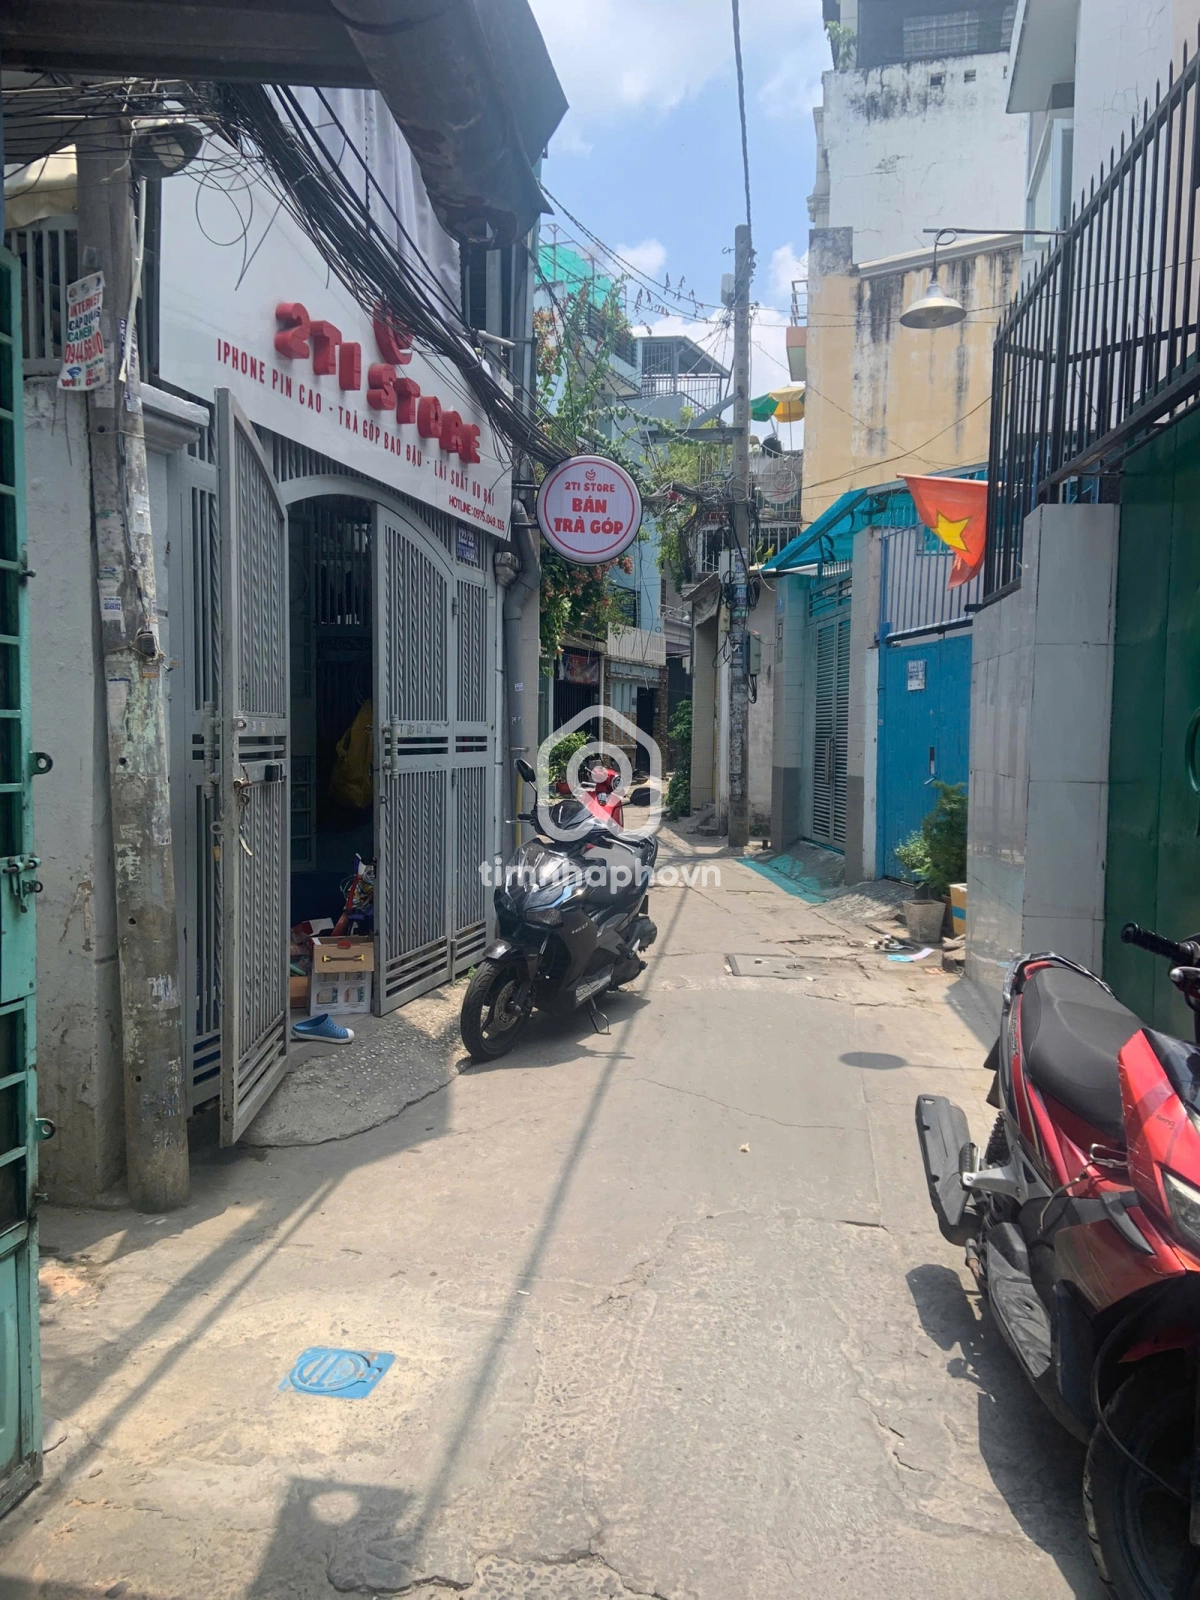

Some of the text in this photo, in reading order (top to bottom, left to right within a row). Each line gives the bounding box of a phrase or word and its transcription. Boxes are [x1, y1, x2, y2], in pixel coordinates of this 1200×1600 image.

[274, 302, 480, 464] 2TI STORE
[217, 338, 265, 385] IPHONE
[272, 368, 292, 399] PIN
[299, 384, 322, 414] CAO
[363, 419, 380, 445] GÓP
[384, 432, 401, 457] BAO
[564, 481, 616, 493] 2TI STORE
[572, 495, 607, 514] BÁN
[553, 516, 624, 535] TRẢ GÓP
